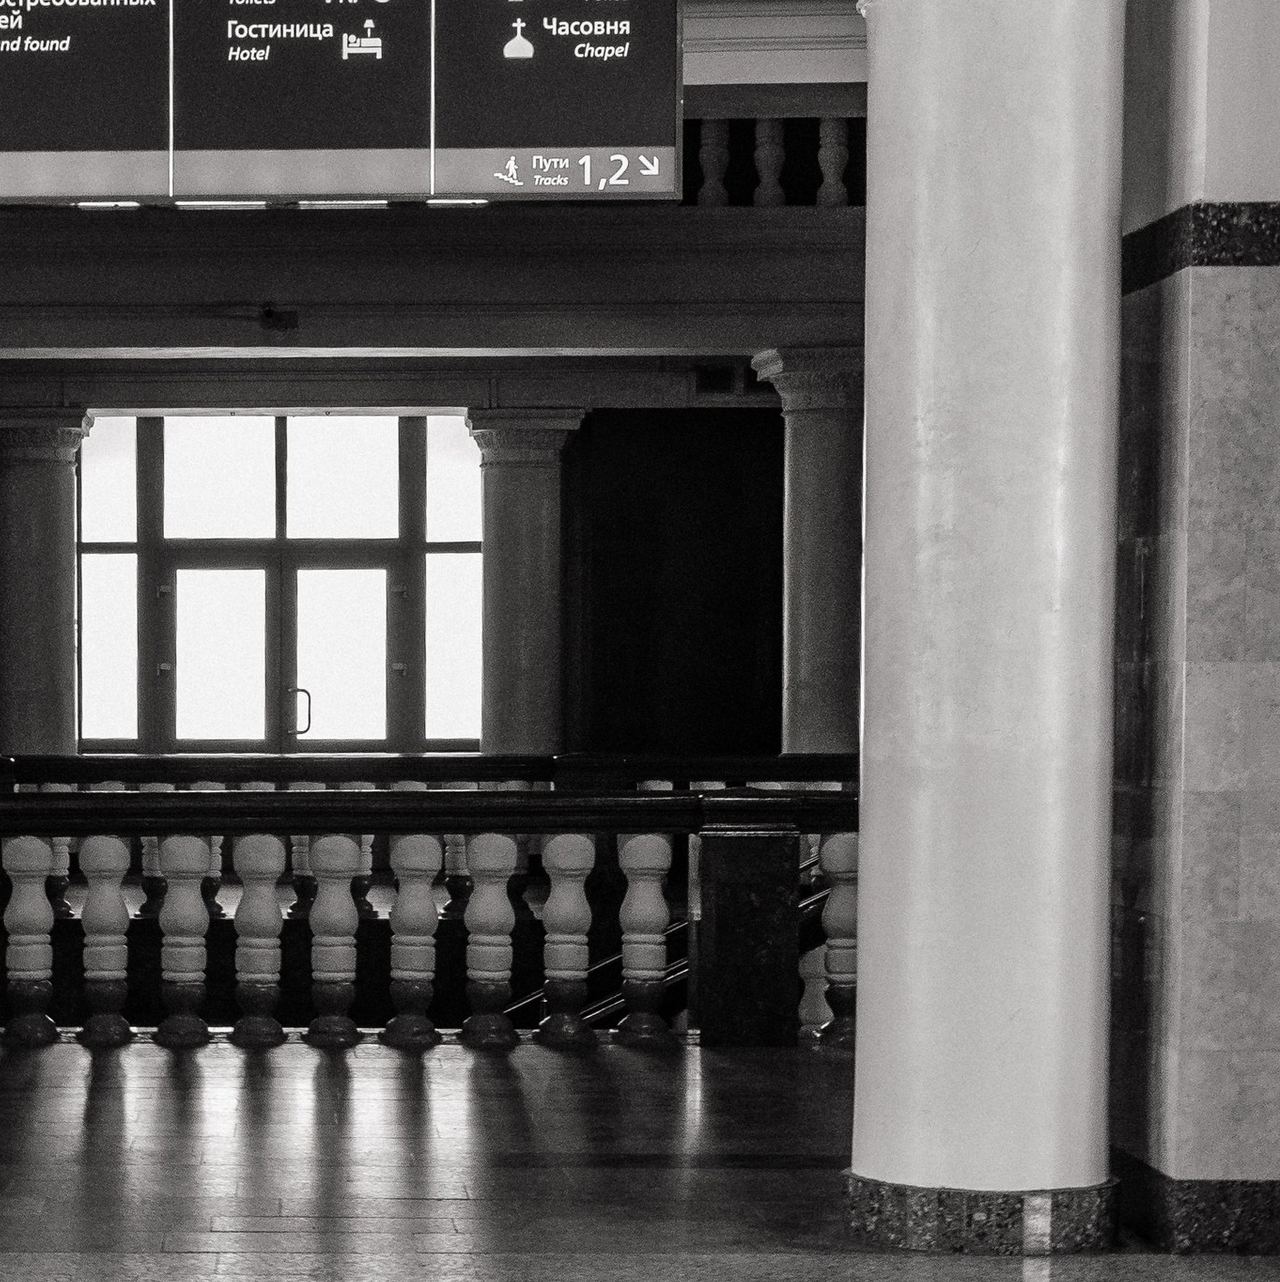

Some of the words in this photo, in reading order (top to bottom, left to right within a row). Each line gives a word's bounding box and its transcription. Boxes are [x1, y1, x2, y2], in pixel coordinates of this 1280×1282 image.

[228, 20, 333, 40] Гостиница
[543, 17, 630, 35] Часовня
[24, 36, 70, 51] found
[228, 45, 270, 60] Hotel
[574, 42, 629, 61] Chapel
[533, 156, 569, 172] Пути
[578, 155, 630, 190] 1,2
[534, 175, 569, 186] Tracks
